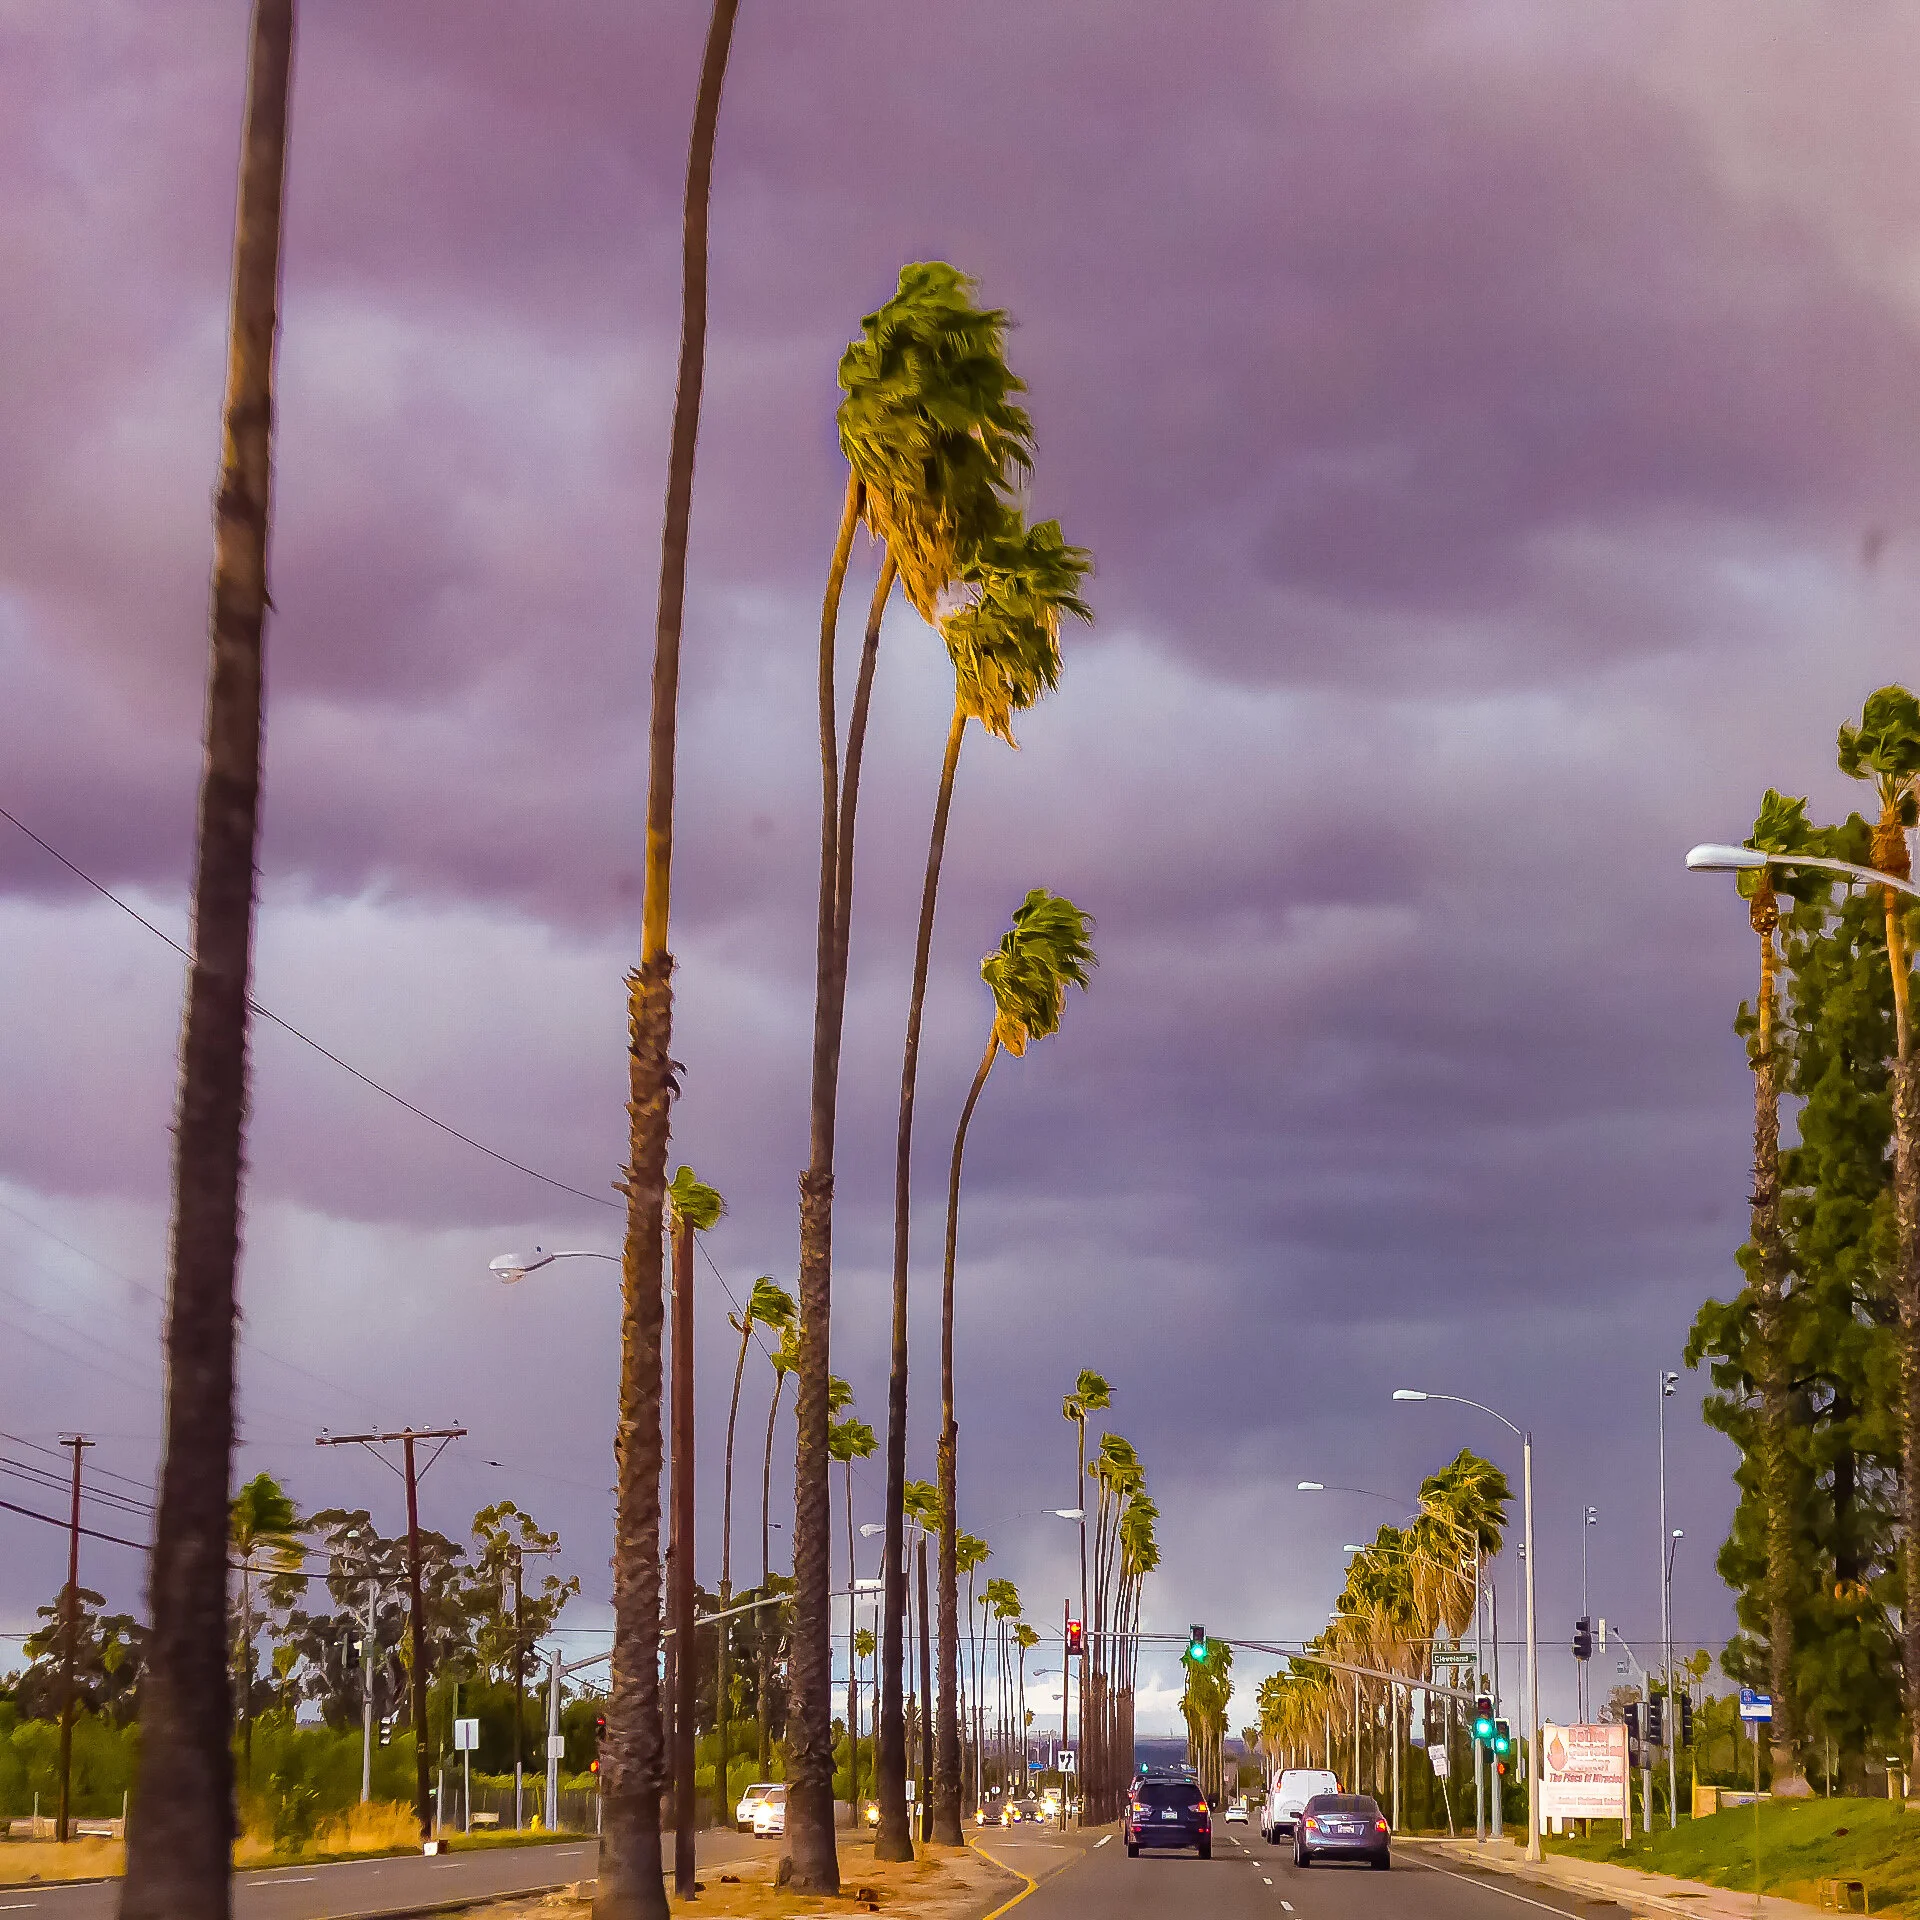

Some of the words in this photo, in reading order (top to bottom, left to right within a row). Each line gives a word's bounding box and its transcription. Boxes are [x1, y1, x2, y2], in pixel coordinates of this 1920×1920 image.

[1434, 1655, 1468, 1663] Cleveland
[1550, 1773, 1562, 1782] The
[1593, 1774, 1624, 1783] Miracles
